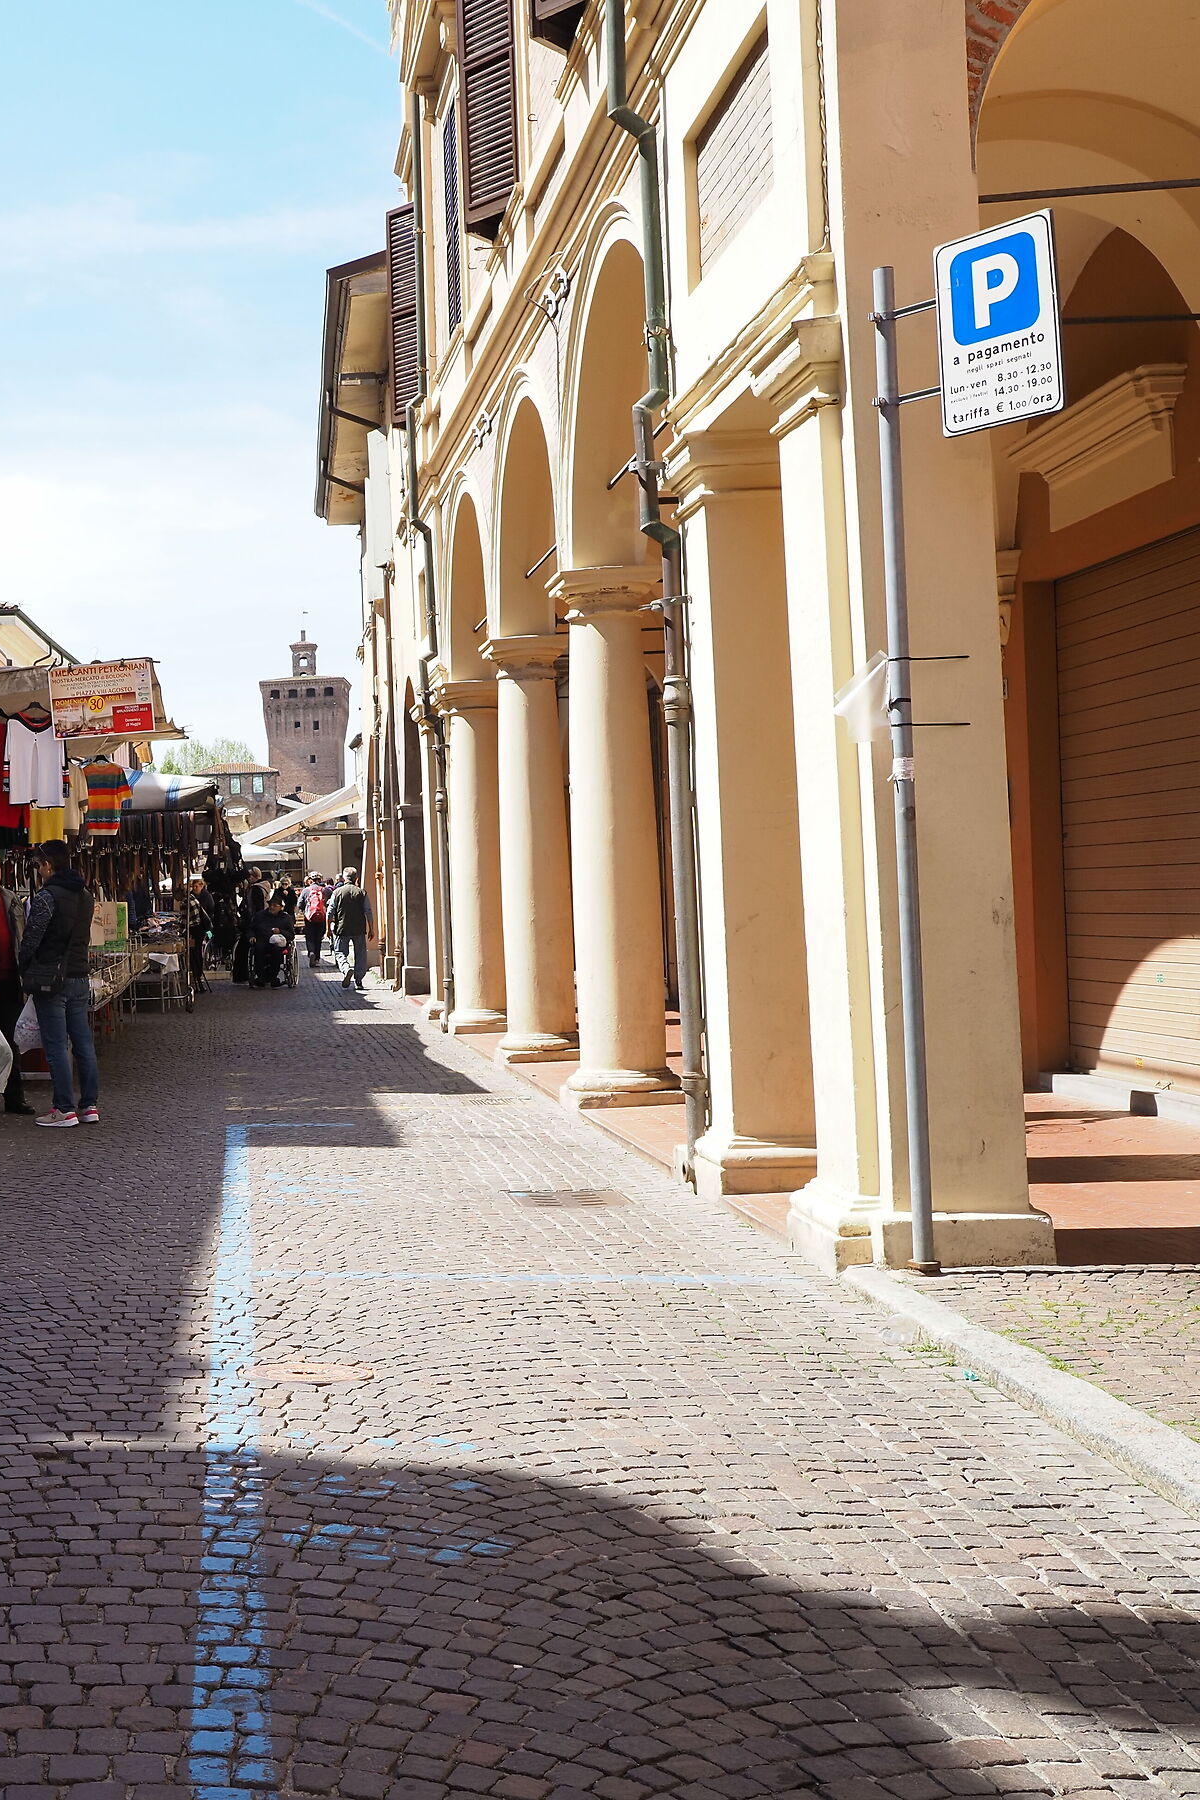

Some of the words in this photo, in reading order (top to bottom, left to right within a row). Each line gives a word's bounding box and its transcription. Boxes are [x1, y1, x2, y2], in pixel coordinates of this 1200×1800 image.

[971, 252, 1020, 330] P
[953, 356, 960, 365] a
[967, 332, 1045, 364] pagamento
[966, 365, 983, 374] negli
[986, 359, 1004, 369] spazi
[1006, 351, 1033, 364] segnati
[997, 370, 1018, 382] 8.30
[1026, 361, 1052, 375] 12.30
[950, 379, 988, 395] lun-ven
[994, 383, 1019, 396] 14.30
[1027, 375, 1053, 388] 19.00
[952, 406, 990, 424] tariffa
[996, 401, 1004, 413] €
[52, 675, 100, 685] MOSTRA-MERCATO
[105, 672, 132, 680] BOLOGNA
[54, 667, 97, 679] MERCANTI
[98, 662, 148, 674] PETRONIANI
[107, 686, 133, 694] AGOSTO
[55, 698, 89, 707] DOMENICA
[89, 697, 104, 711] 30
